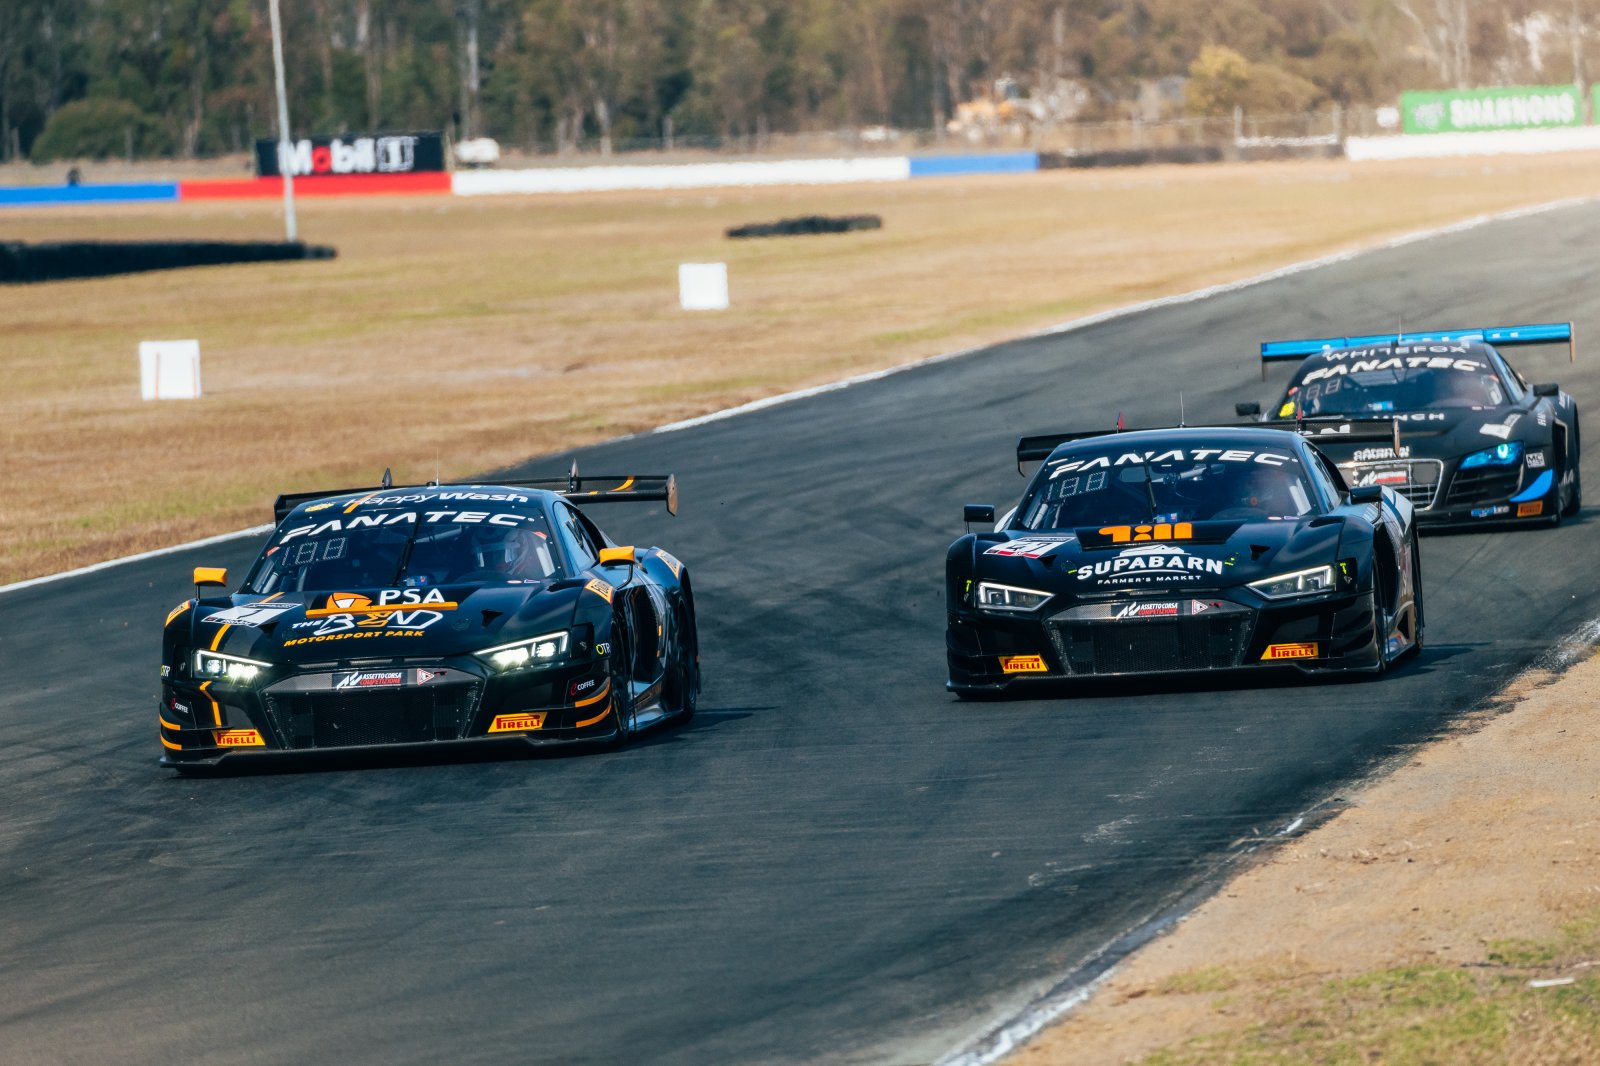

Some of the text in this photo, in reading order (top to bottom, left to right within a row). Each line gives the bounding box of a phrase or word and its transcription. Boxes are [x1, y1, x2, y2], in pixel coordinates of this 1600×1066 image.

[278, 138, 375, 175] Mobil
[1302, 357, 1480, 385] FANATEC
[1049, 449, 1291, 480] FANATEC
[342, 492, 529, 508] Happy Wash
[279, 511, 529, 544] FANATEC
[1077, 556, 1223, 580] SUPABARN
[1097, 577, 1151, 585] FARMER'S
[379, 588, 446, 606] PSA
[292, 620, 324, 629] THE
[284, 631, 383, 647] MOTORSPORT
[1270, 643, 1314, 658] PIRELLI
[1003, 658, 1040, 670] PIRELLI
[577, 680, 595, 691] COFFEE
[496, 714, 540, 729] PIRELLI
[217, 731, 256, 745] PIRELLI
